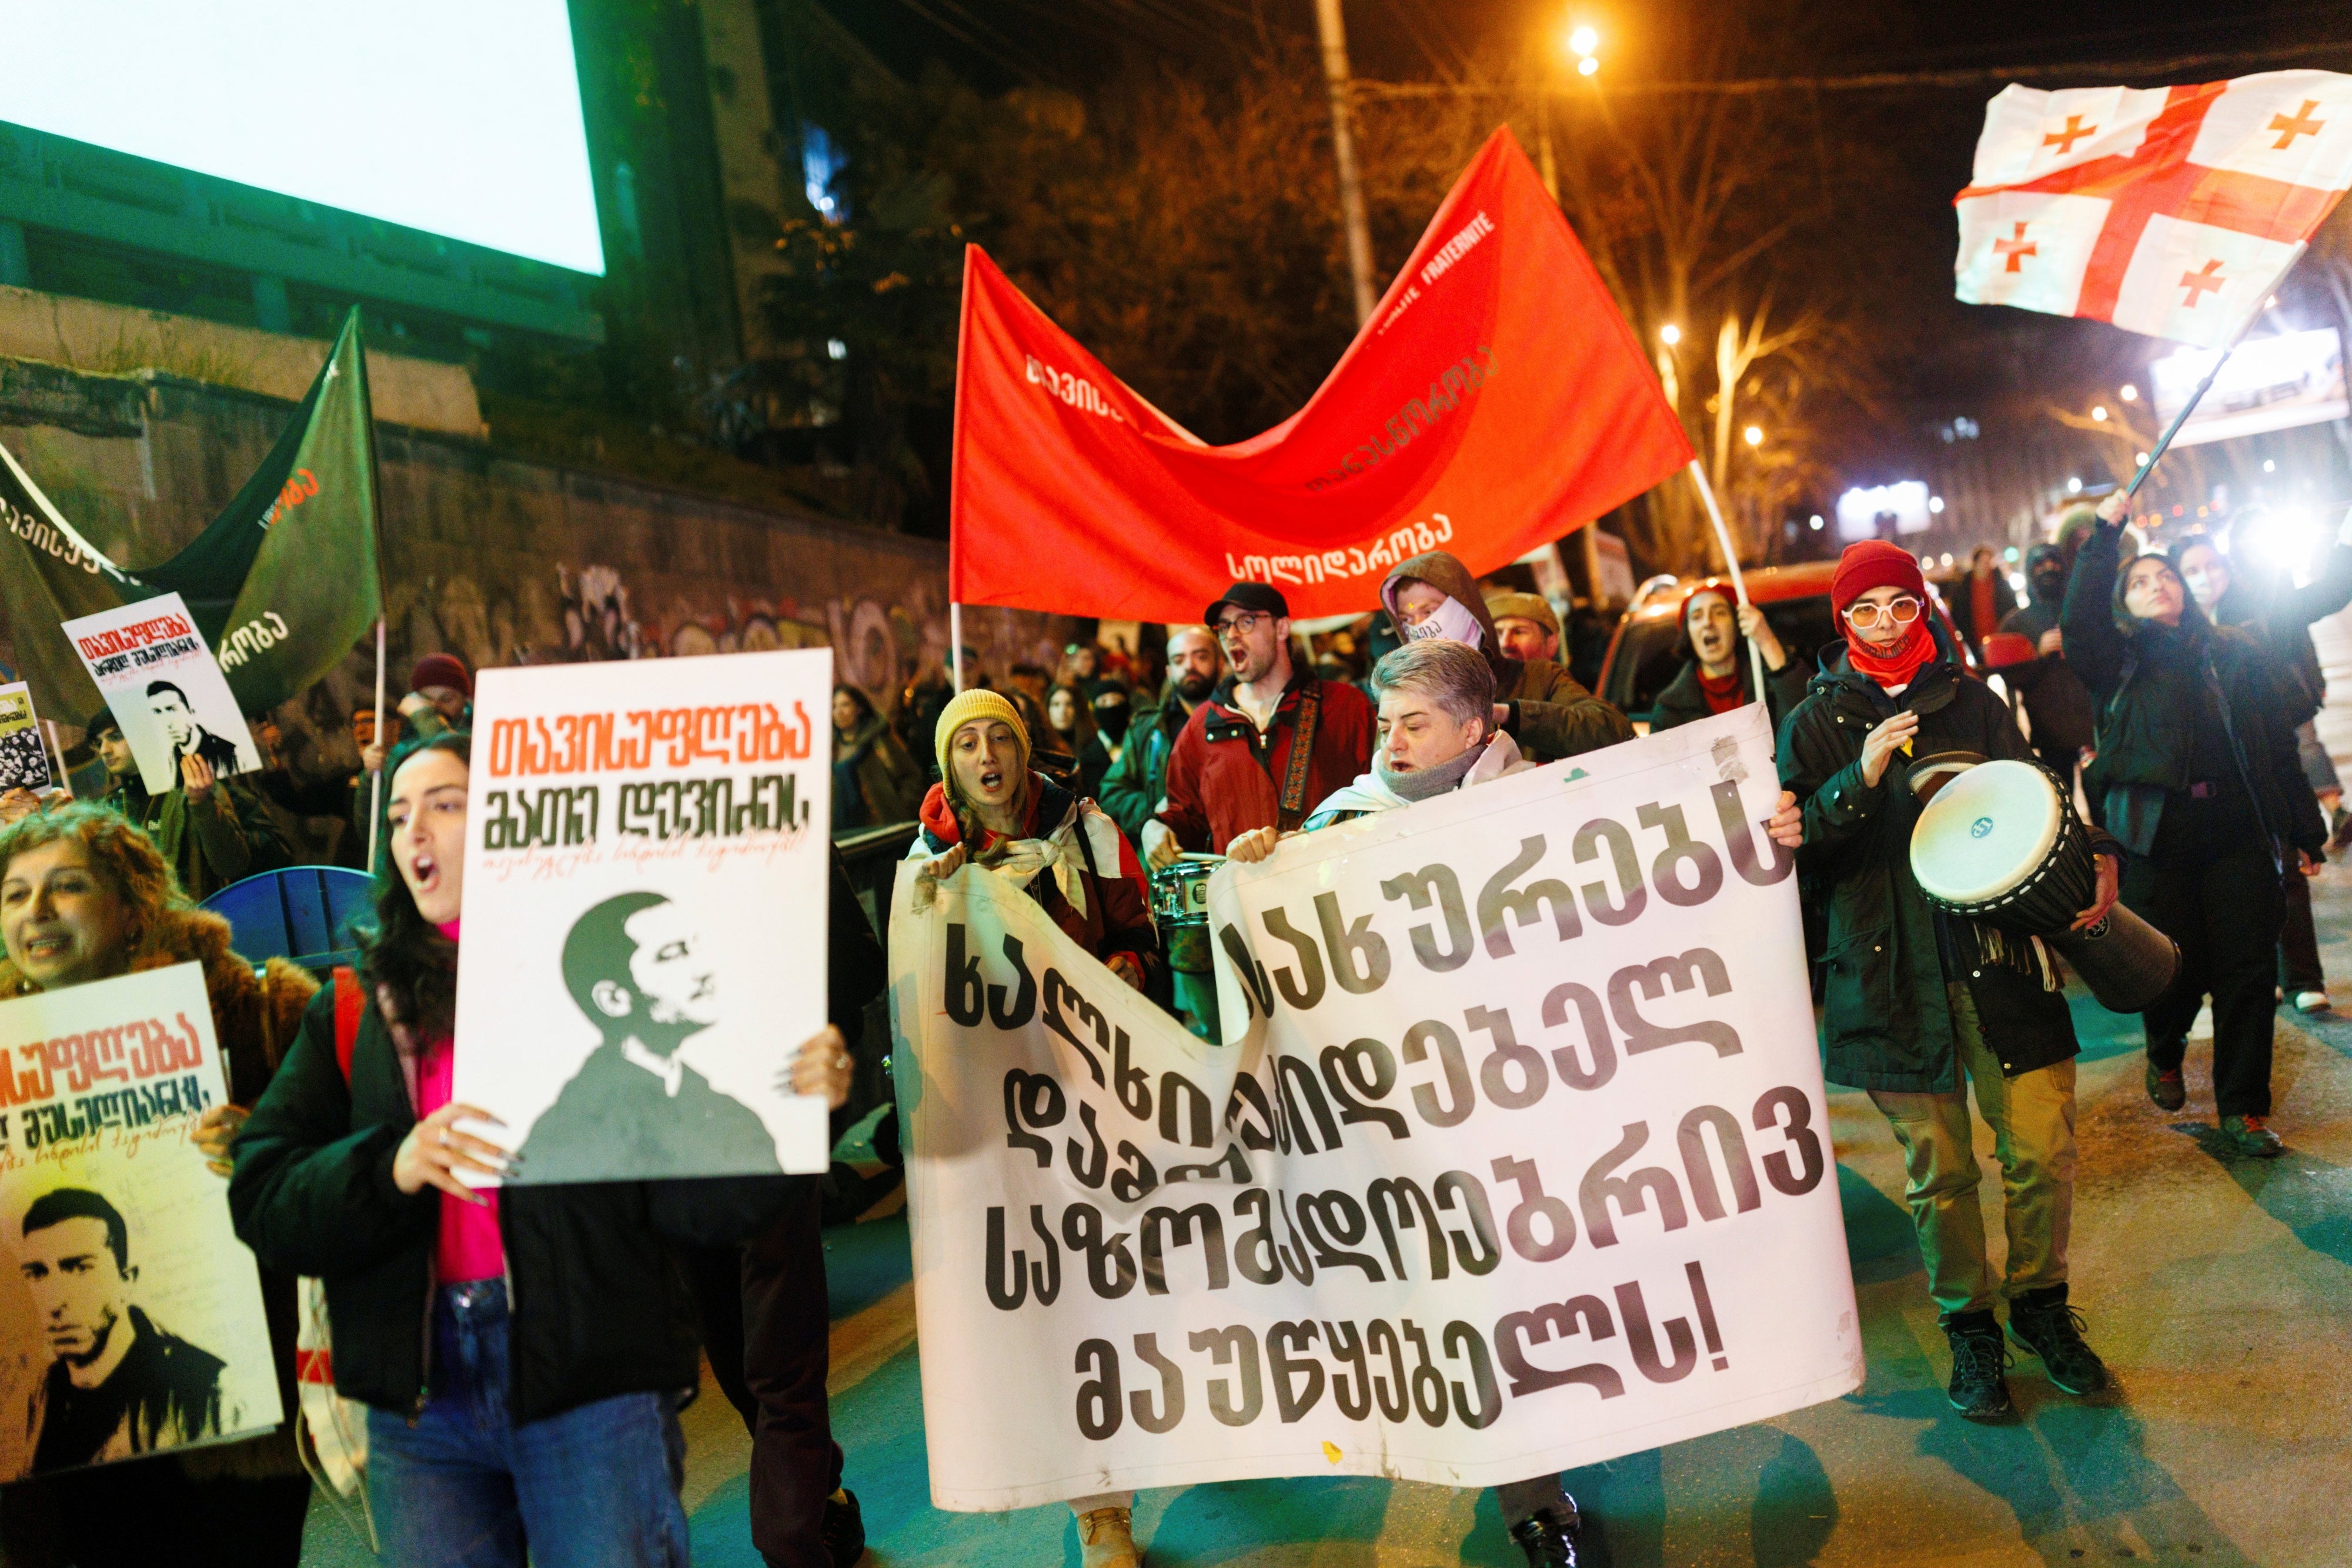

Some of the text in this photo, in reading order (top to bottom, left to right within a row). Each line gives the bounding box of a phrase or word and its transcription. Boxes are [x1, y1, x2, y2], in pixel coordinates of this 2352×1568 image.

[1225, 513, 1453, 585] სოლიდარობა
[78, 612, 192, 660] თავისუფლება
[489, 700, 812, 778] თავისუფლება
[485, 773, 810, 851] მათე დევიძეს
[944, 924, 1214, 1149] ხალხი
[985, 1085, 1825, 1310] საზოგადოებრივ
[1075, 1262, 1729, 1440] მაუწყებელს!
